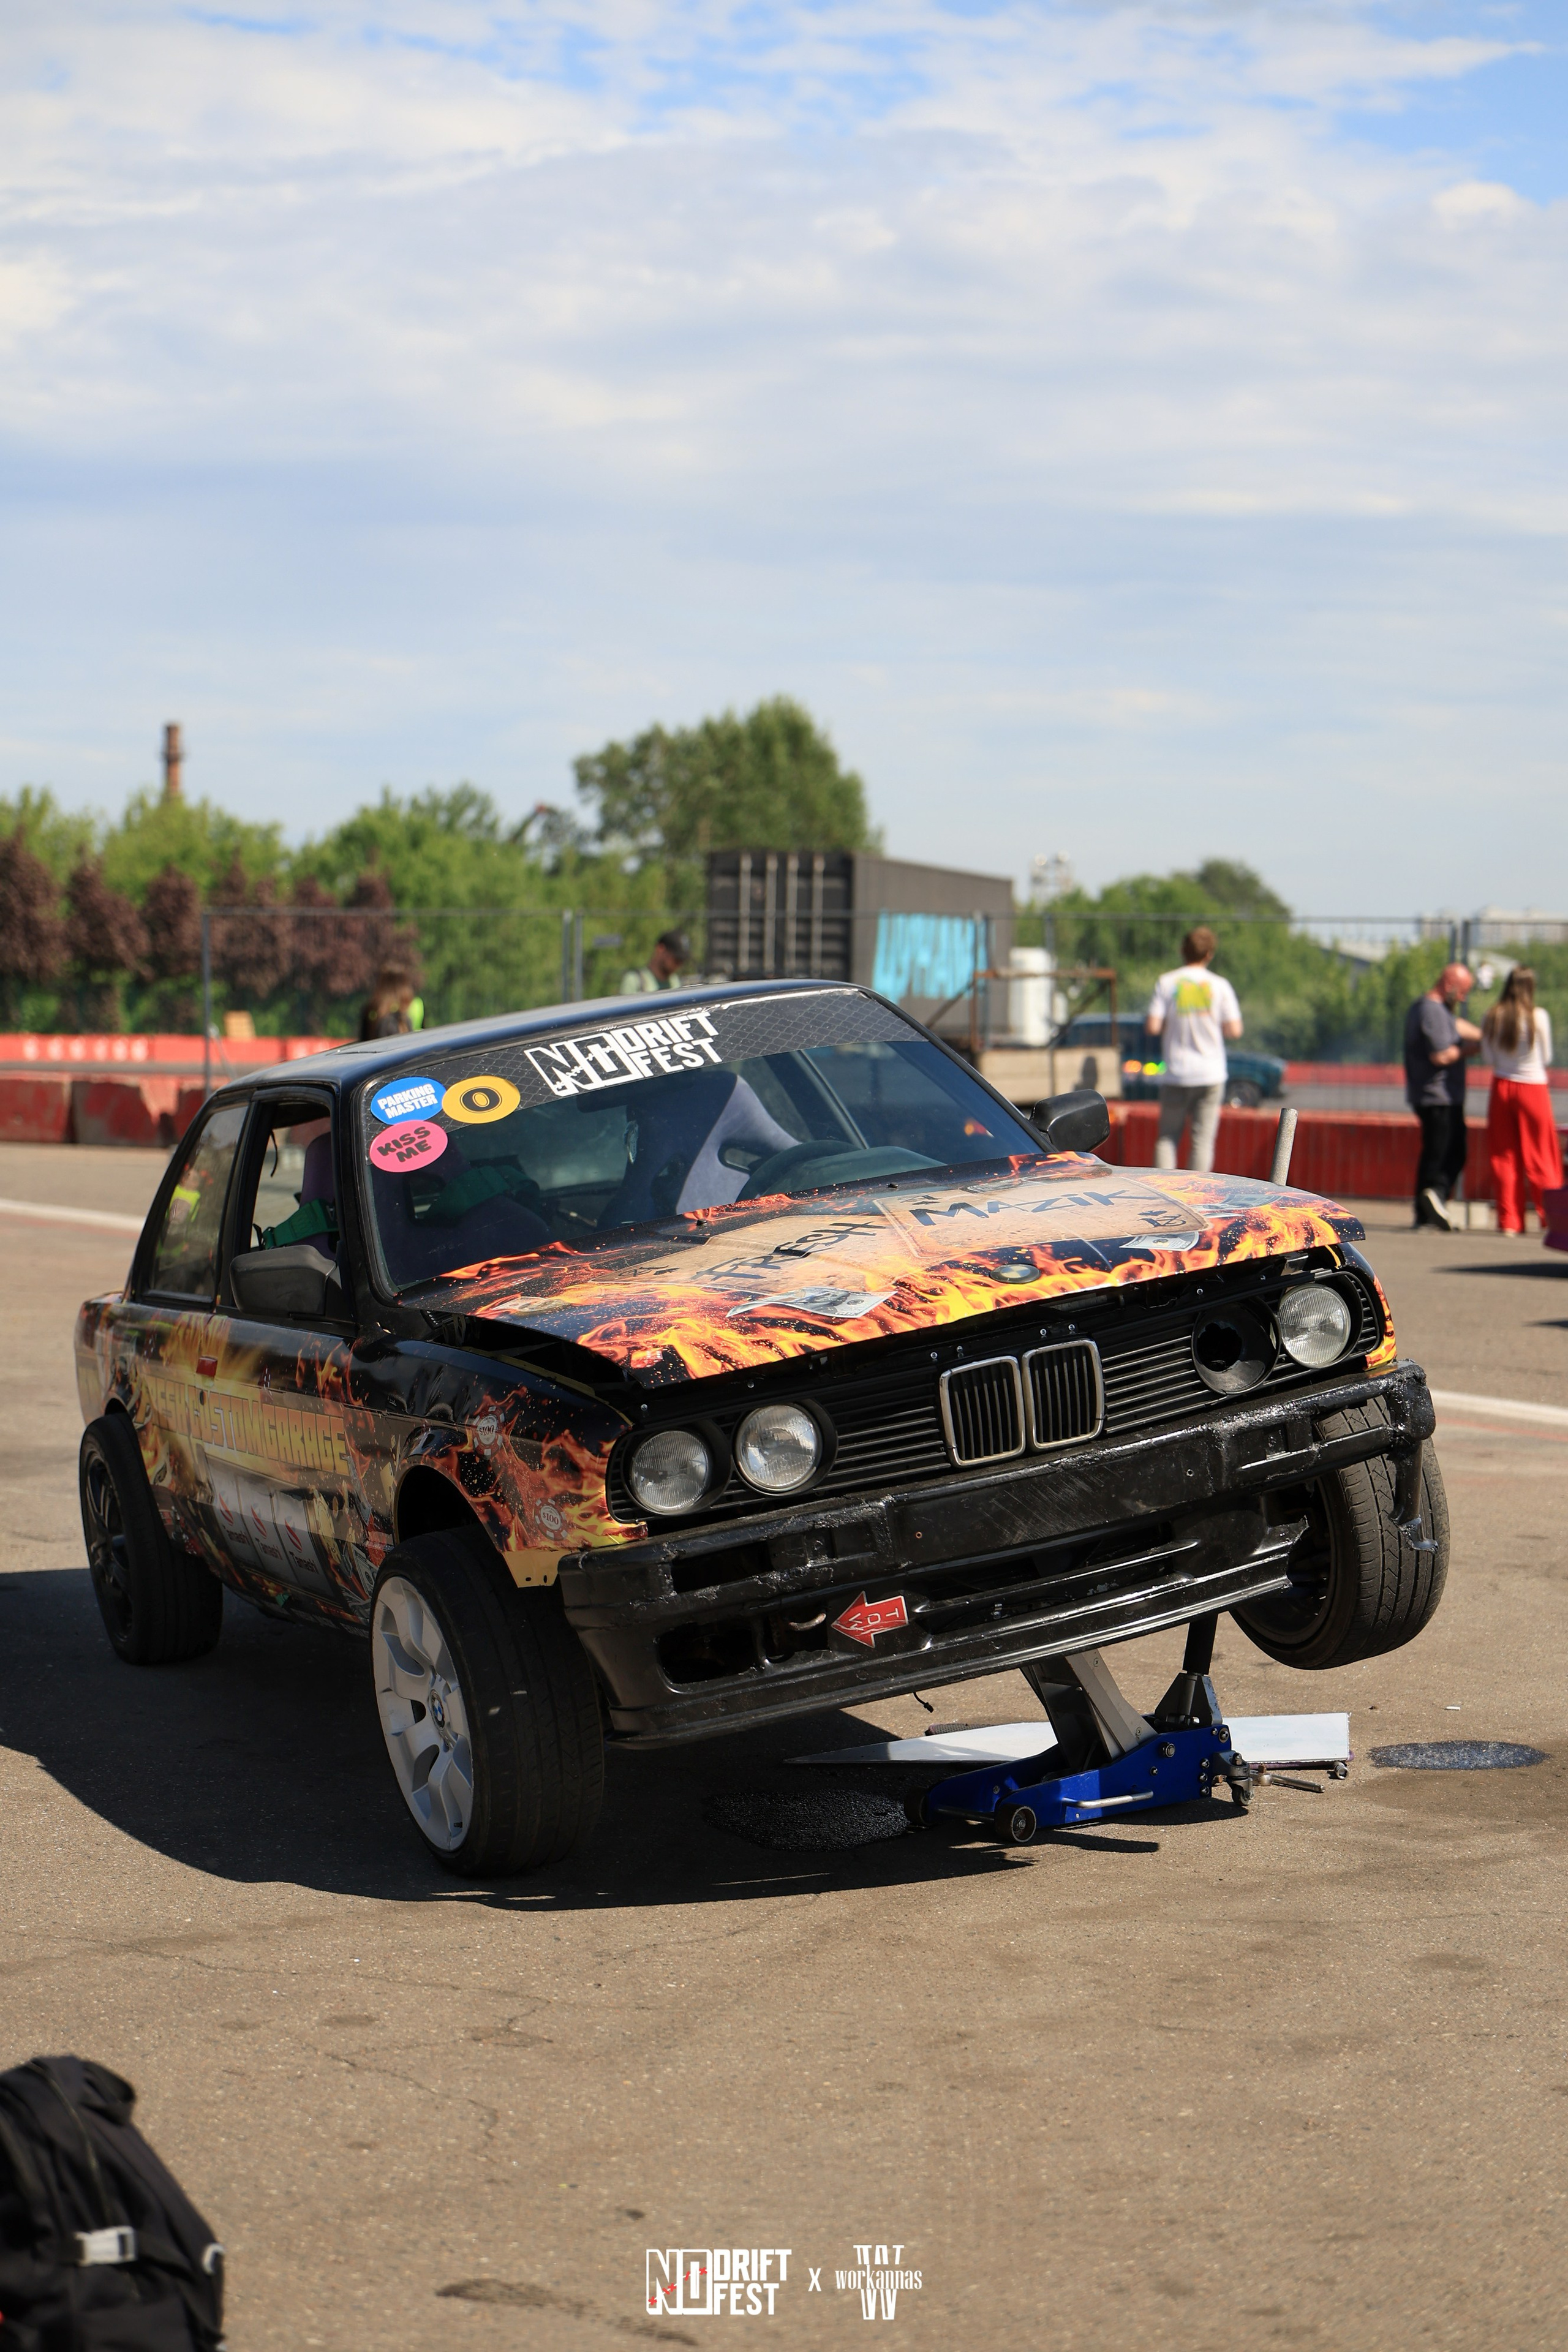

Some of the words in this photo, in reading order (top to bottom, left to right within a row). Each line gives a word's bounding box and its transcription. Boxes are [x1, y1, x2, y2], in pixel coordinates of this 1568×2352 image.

[611, 1012, 719, 1053] DRIFT
[627, 1038, 723, 1078] FEST
[377, 1084, 435, 1110] PARKING
[384, 1094, 438, 1119] MASTER
[377, 1126, 431, 1156] KISS
[396, 1140, 432, 1163] ME
[690, 1221, 888, 1281] FRESH
[135, 1374, 190, 1437] FRESH
[187, 1385, 265, 1457] CUSTOM
[262, 1403, 350, 1476] GARAGE
[479, 1425, 494, 1436] $100
[543, 1512, 559, 1525] $100
[848, 1608, 900, 1631] TOW
